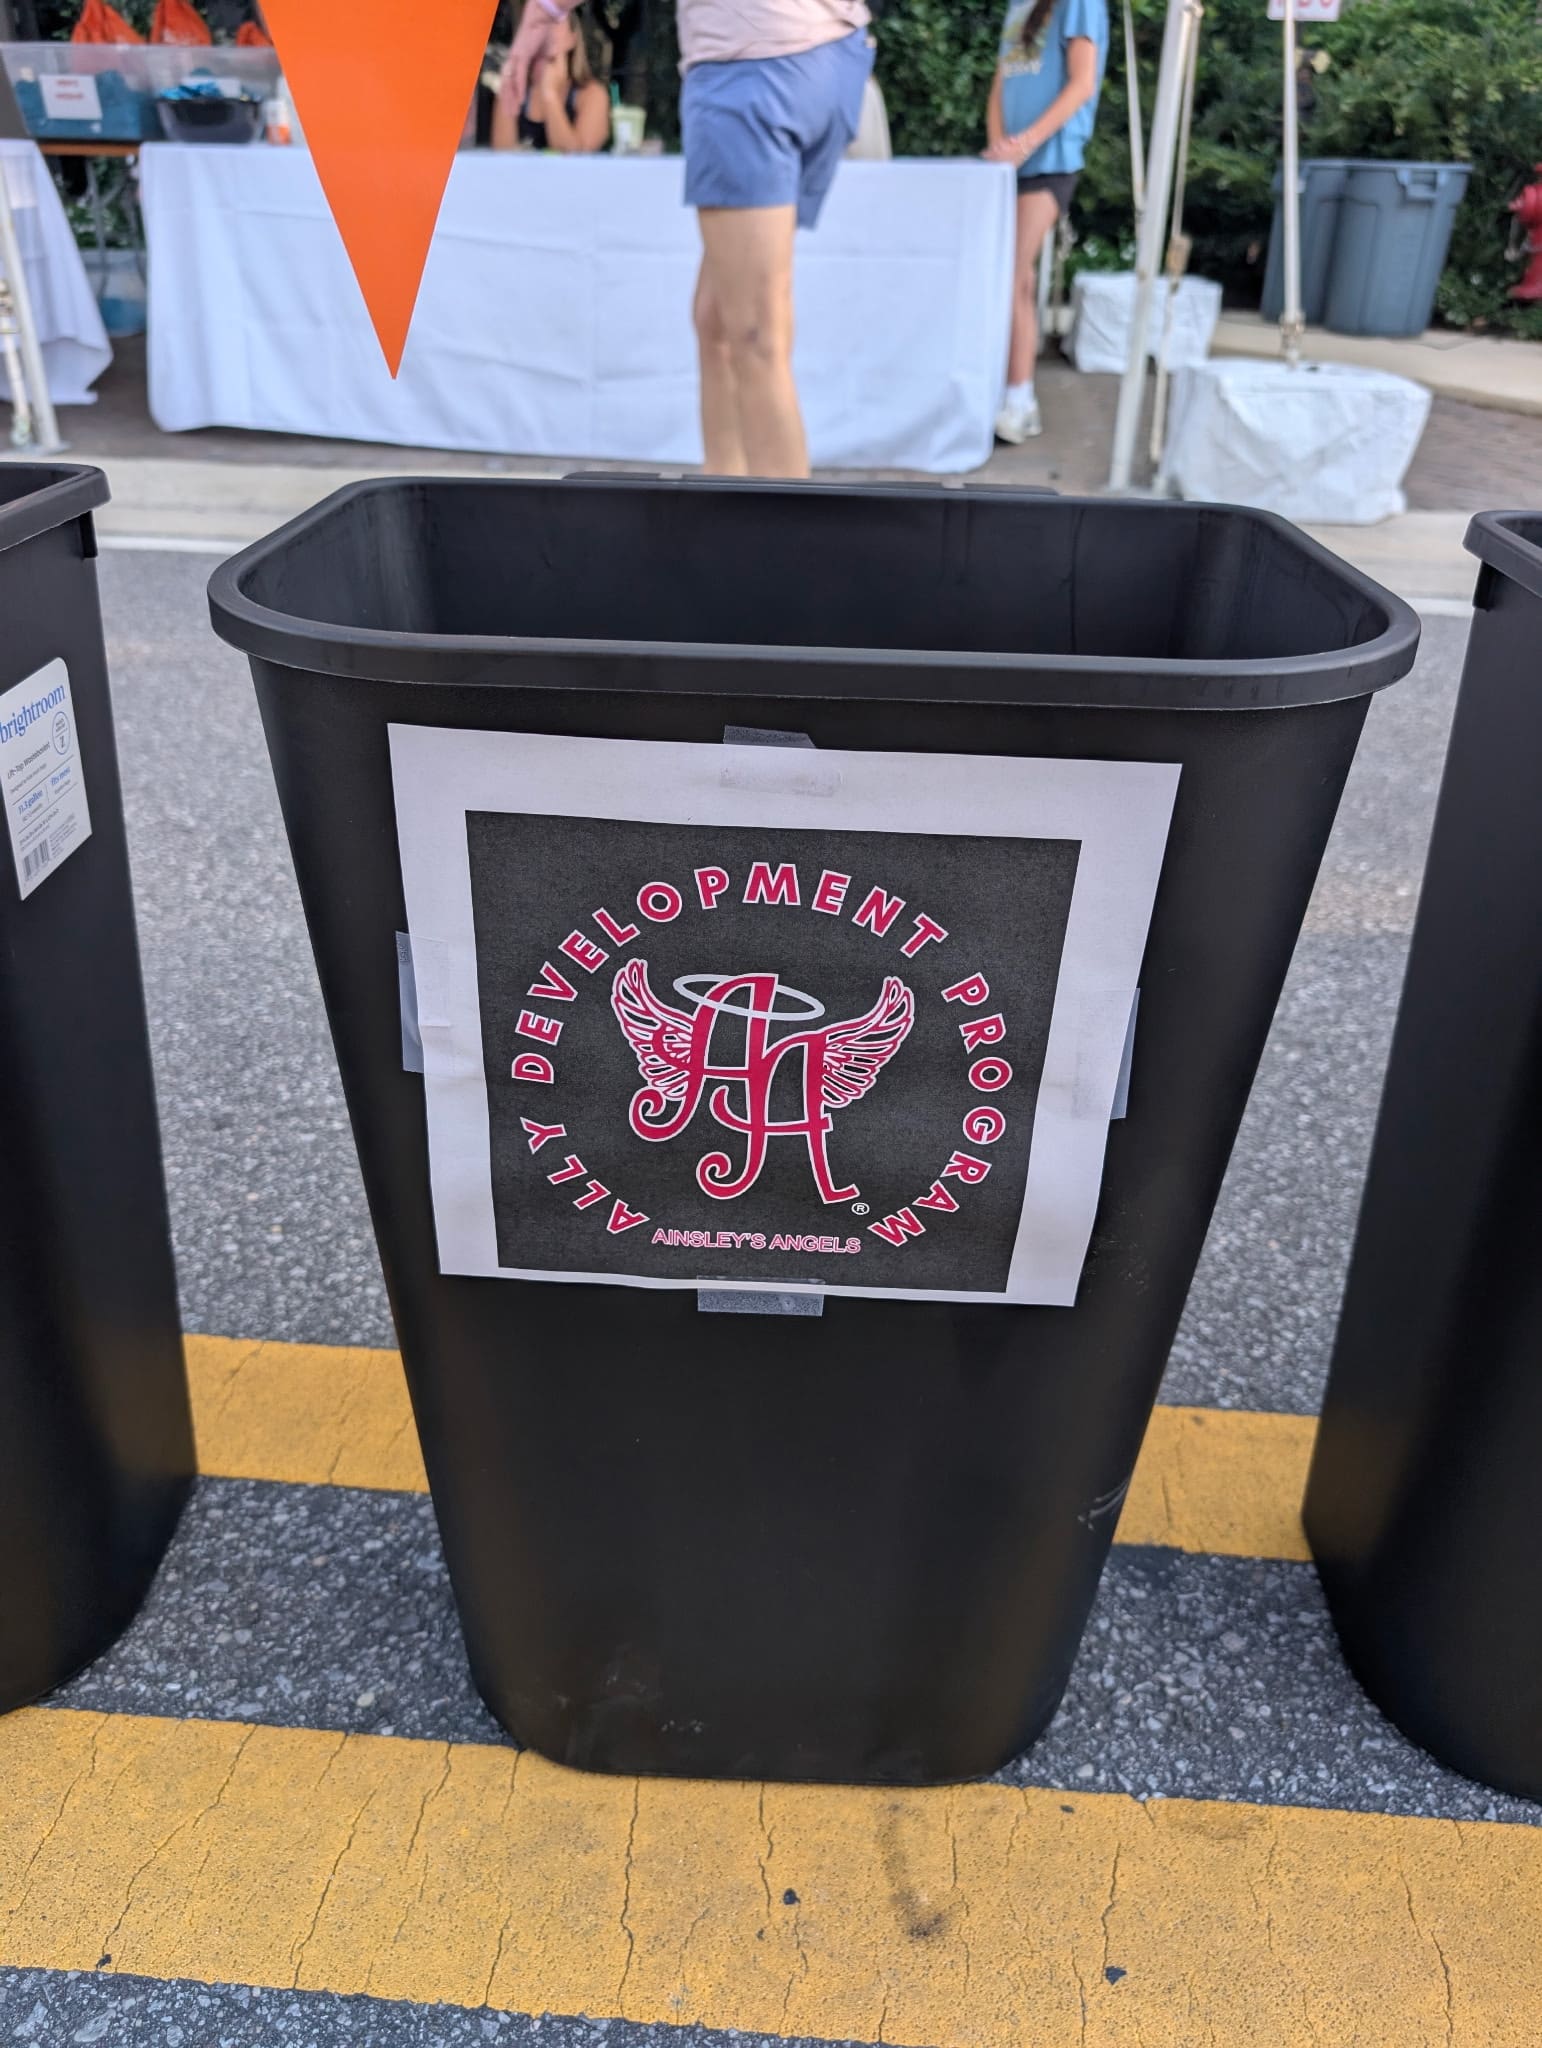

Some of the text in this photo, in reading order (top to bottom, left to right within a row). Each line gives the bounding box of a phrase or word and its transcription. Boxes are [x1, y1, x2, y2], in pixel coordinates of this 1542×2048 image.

[0, 685, 65, 744] brightroom
[512, 862, 1013, 1247] ALLY DEVELOPMENT PROGRAM
[652, 1228, 861, 1253] AINSLEY'S ANGELS
